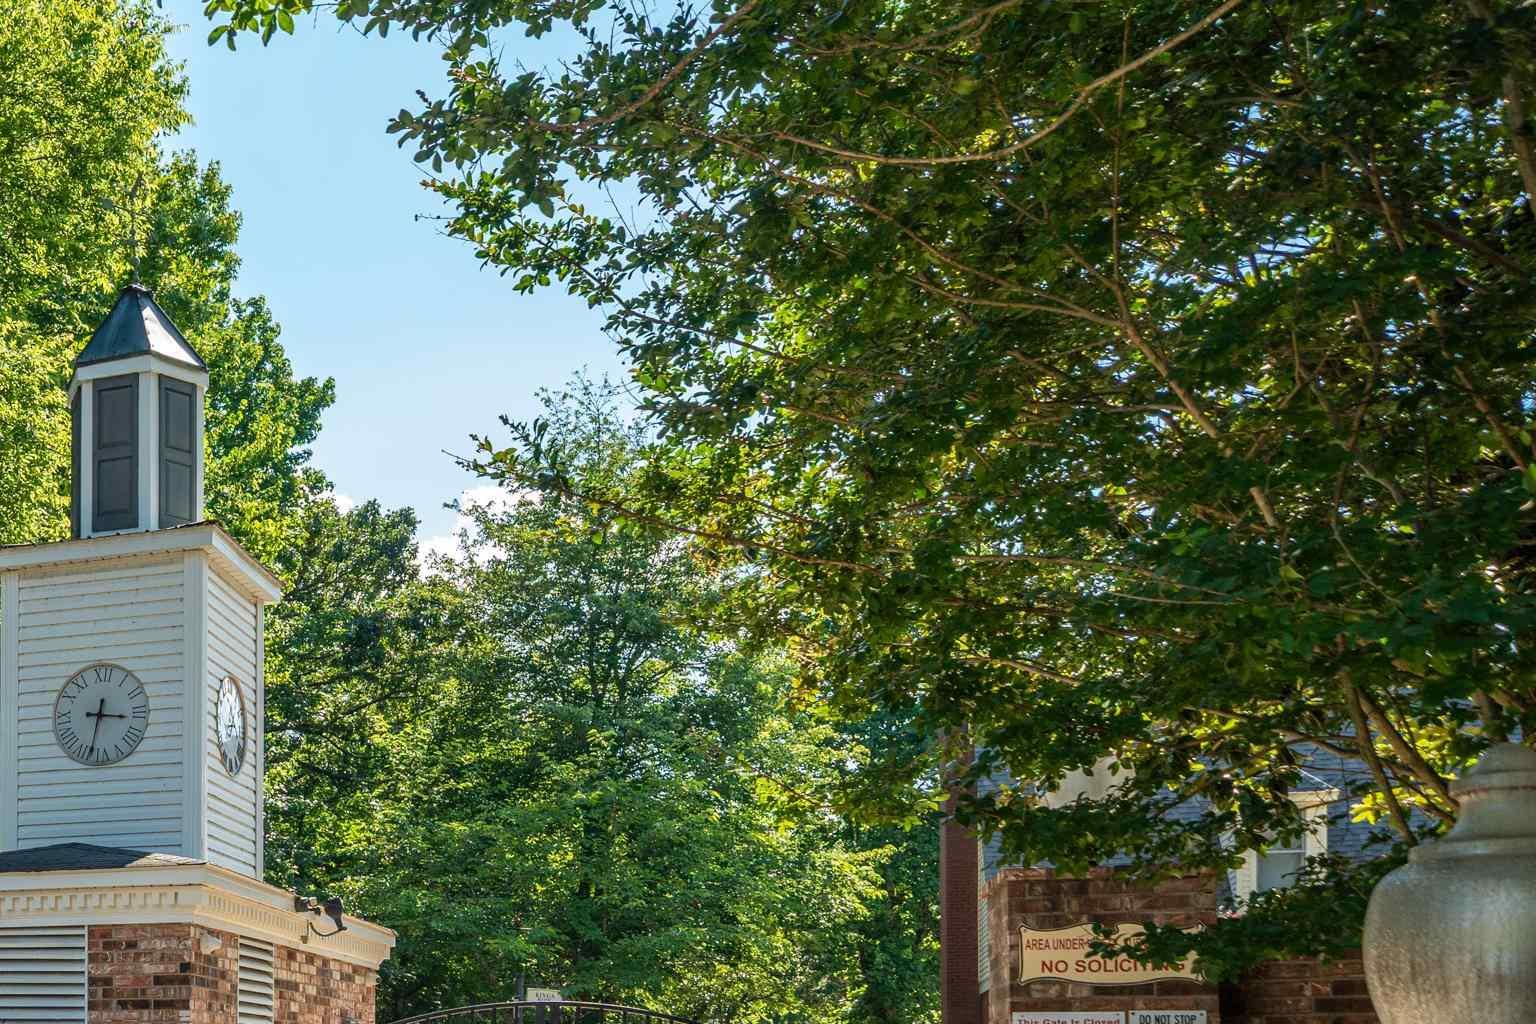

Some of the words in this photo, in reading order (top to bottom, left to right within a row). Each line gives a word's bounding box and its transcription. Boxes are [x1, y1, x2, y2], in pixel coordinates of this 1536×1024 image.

[1024, 938, 1051, 951] AREA
[1052, 938, 1085, 950] UNDER
[1041, 959, 1068, 973] NO
[1075, 959, 1185, 973] SOLICI
[1139, 1014, 1151, 1024] DO
[1154, 1014, 1171, 1024] NOT
[1174, 1014, 1197, 1024] STOP
